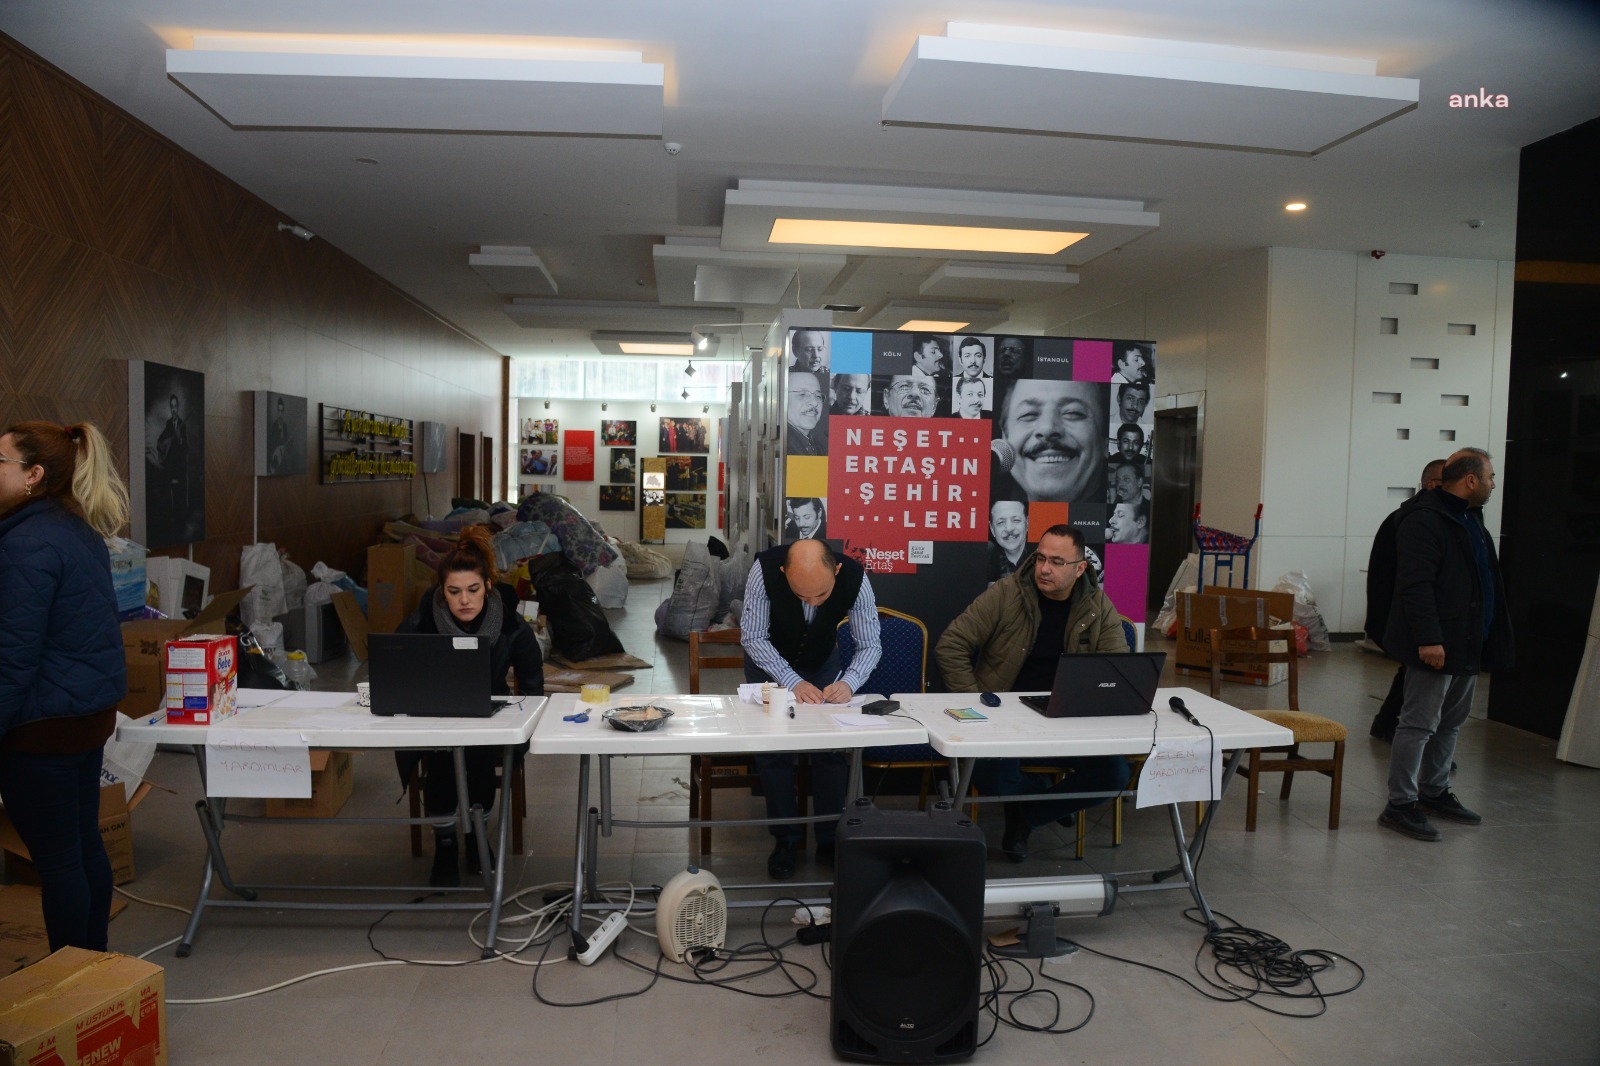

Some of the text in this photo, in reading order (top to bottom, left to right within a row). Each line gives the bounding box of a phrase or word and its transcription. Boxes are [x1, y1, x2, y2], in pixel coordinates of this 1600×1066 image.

[883, 350, 902, 358] KÖLN
[847, 428, 952, 452] NEŞET
[845, 456, 979, 479] ERTAŞ'IN
[859, 480, 963, 505] ŞEHİR
[903, 508, 977, 529] LERİ
[865, 547, 905, 562] Neşet
[865, 560, 893, 572] Ertaş
